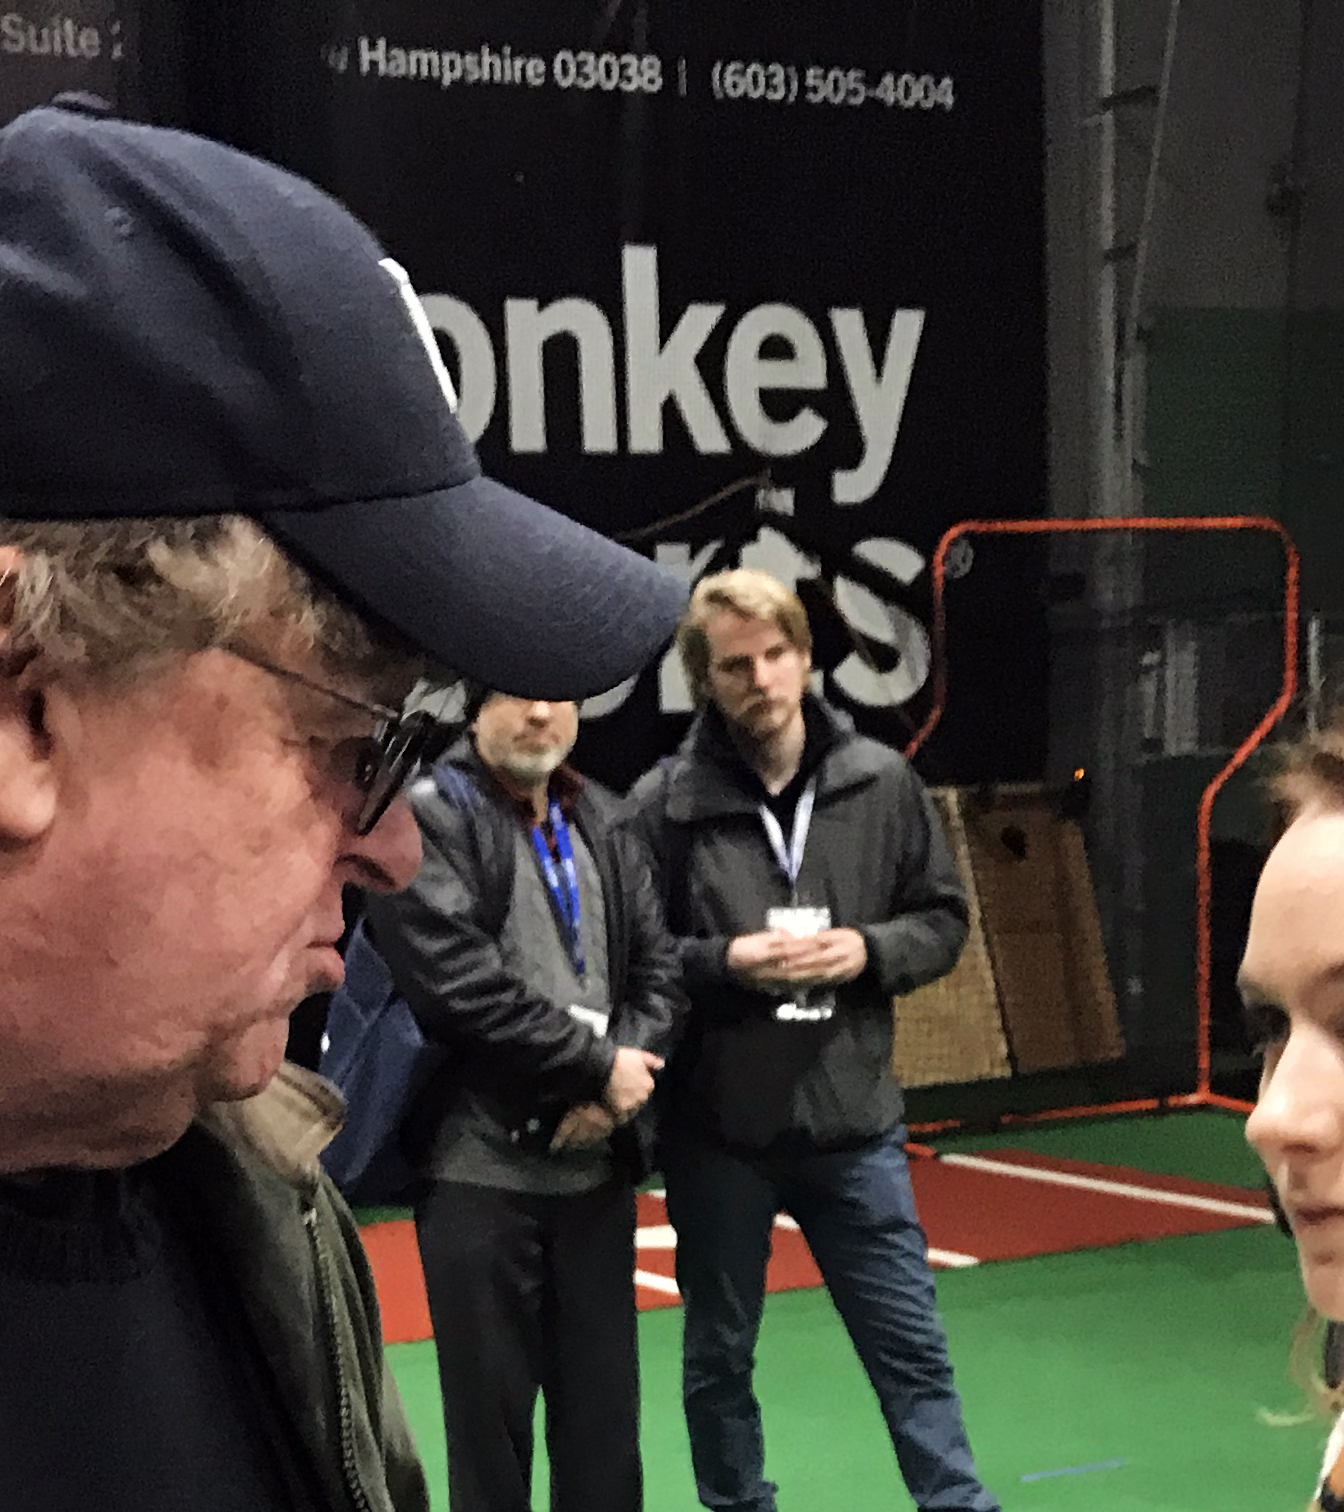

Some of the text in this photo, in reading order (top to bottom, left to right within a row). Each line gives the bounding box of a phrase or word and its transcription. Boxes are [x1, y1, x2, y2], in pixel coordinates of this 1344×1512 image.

[0, 12, 101, 59] Suite
[358, 35, 547, 91] Hampshire
[553, 49, 663, 93] 03038
[711, 58, 799, 105] (603)
[805, 64, 954, 113] 505-4004
[408, 244, 926, 504] onkey
